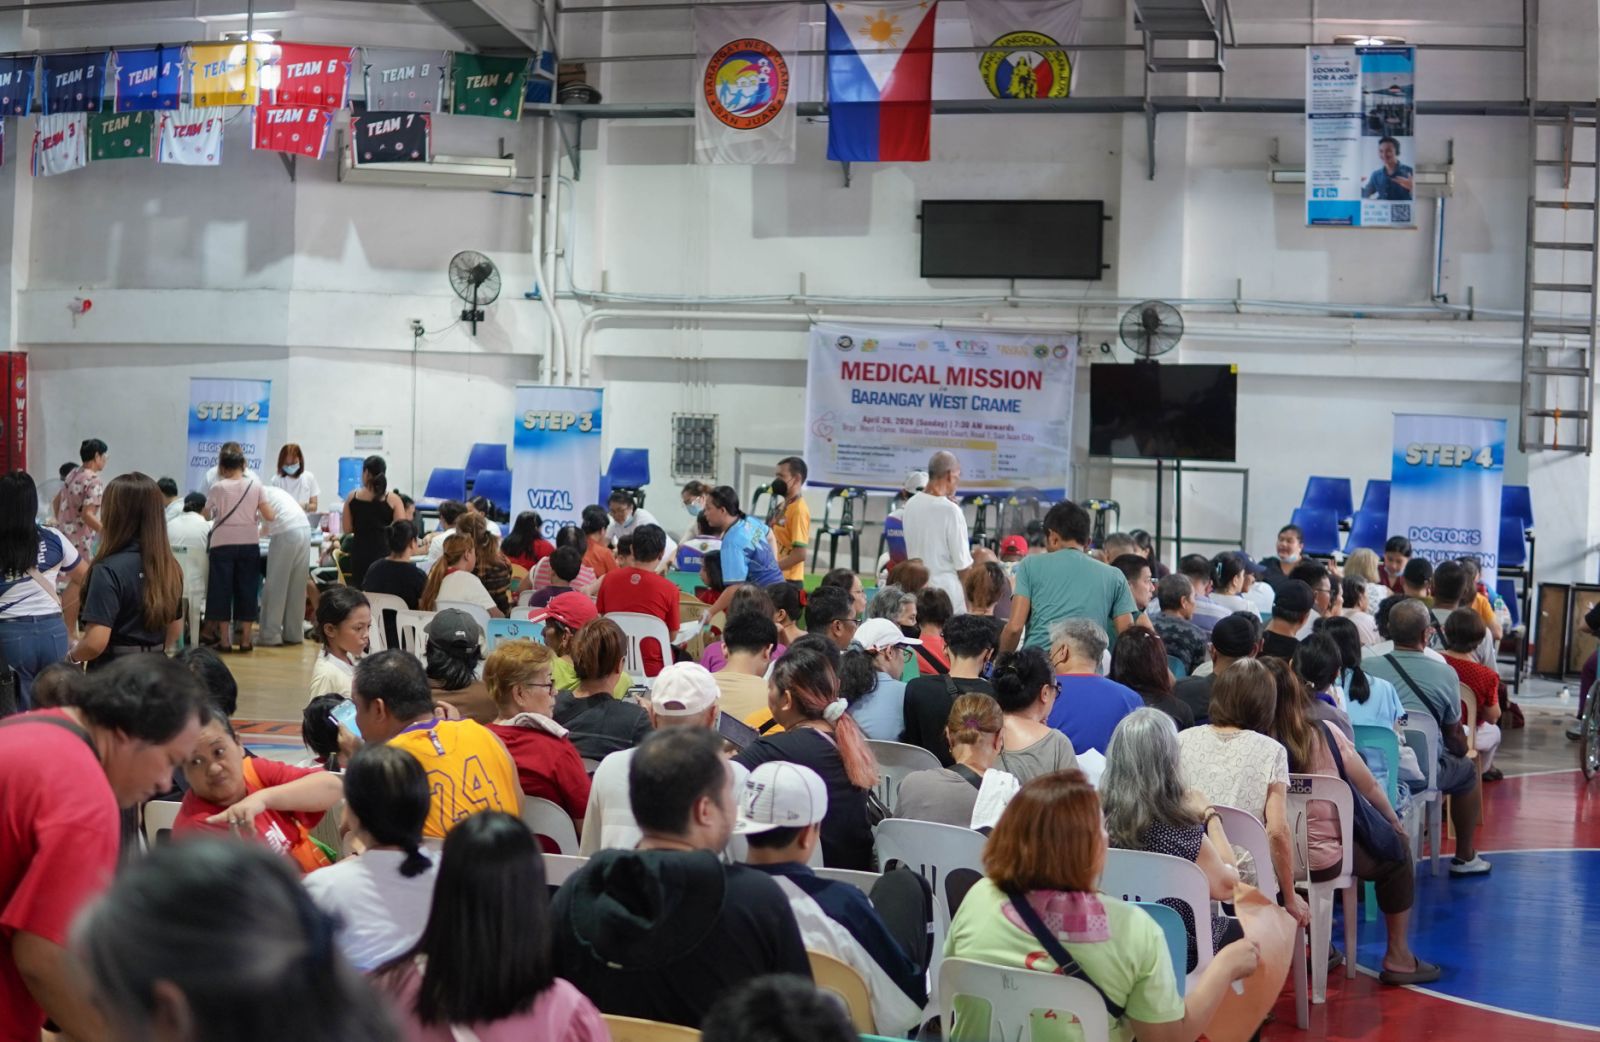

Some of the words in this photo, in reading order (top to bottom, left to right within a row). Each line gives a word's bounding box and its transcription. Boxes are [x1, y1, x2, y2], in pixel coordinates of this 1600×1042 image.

[56, 69, 84, 88] TEAM
[87, 65, 95, 79] 2
[129, 65, 157, 87] TEAM
[203, 61, 236, 79] TEA
[287, 61, 321, 78] TEAM
[327, 59, 337, 74] 6
[382, 68, 415, 83] TEAM
[421, 64, 430, 77] 8
[466, 75, 498, 89] TEAM
[504, 71, 514, 85] 4
[101, 115, 130, 135] TEAM
[134, 110, 142, 124] 4
[267, 109, 302, 124] TEAM
[307, 109, 319, 122] 6
[367, 118, 401, 137] TEAM
[406, 114, 414, 129] 7
[42, 130, 64, 151] TEAM
[68, 122, 75, 136] 3
[173, 125, 202, 139] TEAM
[841, 361, 941, 385] MEDICAL
[946, 366, 1042, 390] MISSION
[197, 402, 245, 421] STEP
[246, 403, 261, 421] 2
[851, 388, 926, 408] BARANGAY
[929, 392, 968, 410] WEST
[971, 395, 1022, 413] CRAME
[524, 410, 576, 431] STEP
[579, 413, 593, 432] 3
[863, 415, 880, 425] April
[191, 456, 209, 467] AND
[1405, 443, 1473, 467] STEP
[1475, 446, 1493, 468] 4
[528, 488, 573, 511] VITAL
[1409, 526, 1482, 544] DOCTOR'S
[427, 755, 504, 832] 24
